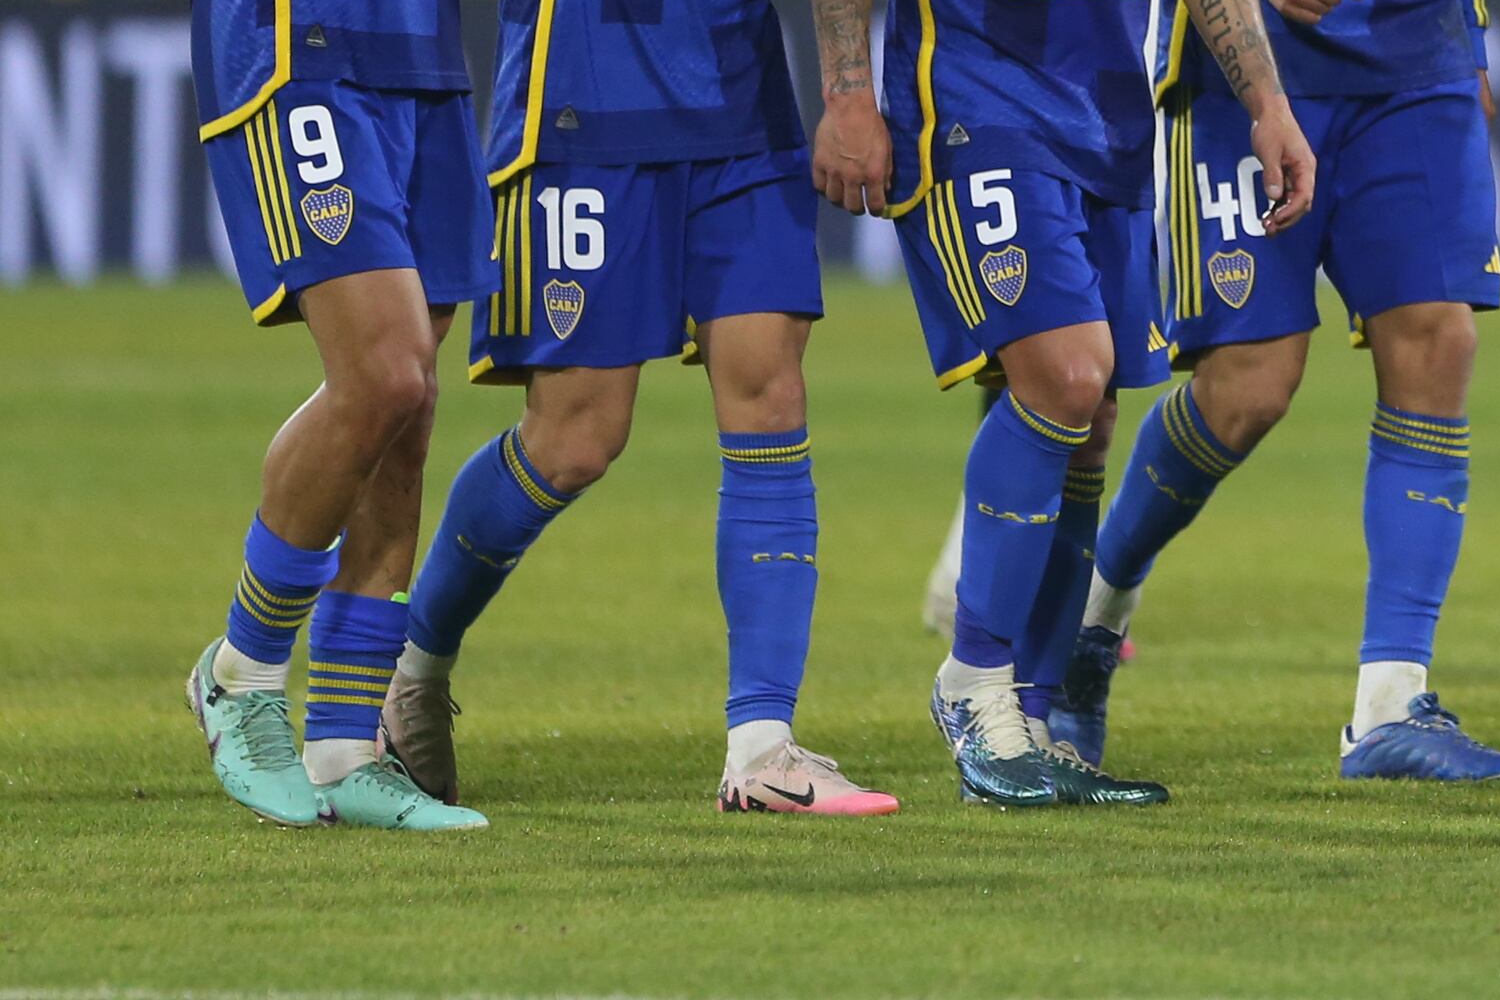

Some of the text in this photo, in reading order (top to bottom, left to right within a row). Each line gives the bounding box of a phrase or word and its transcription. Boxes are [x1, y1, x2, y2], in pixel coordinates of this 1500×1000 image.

[289, 105, 344, 184] 9
[309, 203, 348, 222] CABJ
[969, 168, 1017, 245] 5
[1196, 155, 1276, 241] 40
[537, 187, 605, 270] 16
[988, 264, 1022, 284] CABJ
[1216, 268, 1249, 284] CABJ
[549, 299, 578, 313] CABJ
